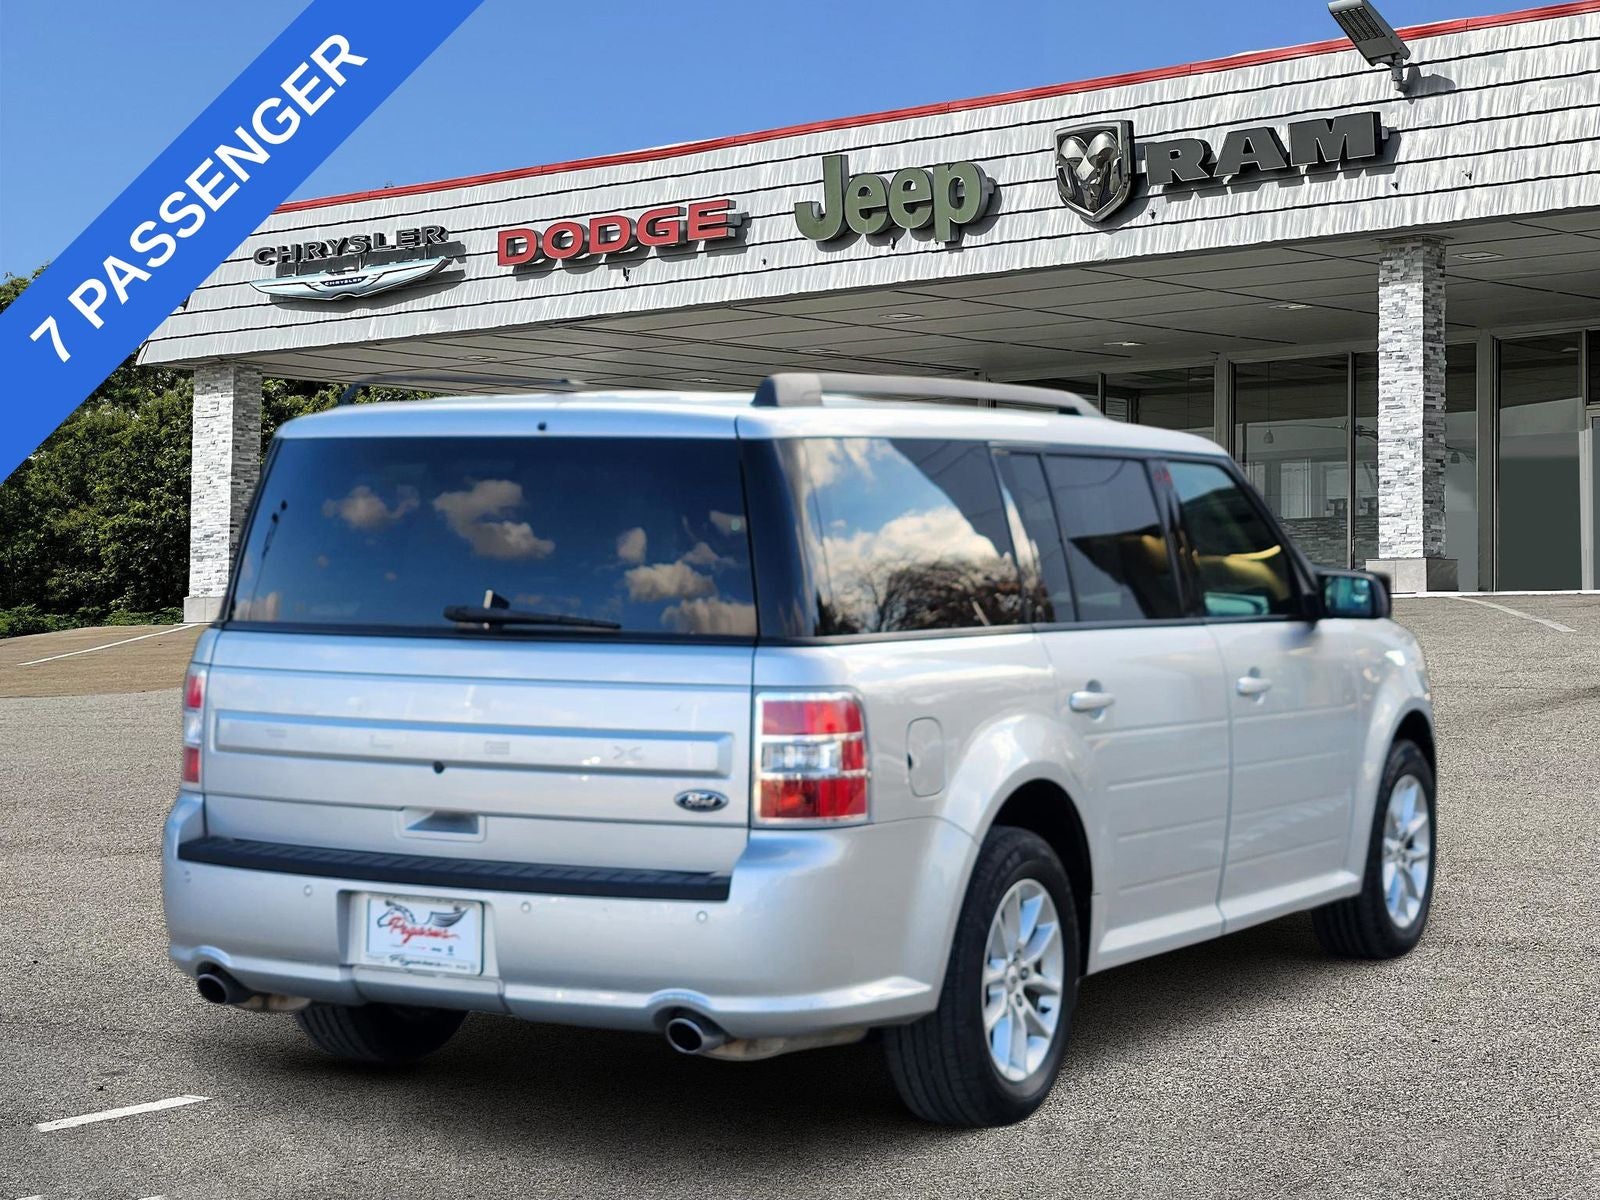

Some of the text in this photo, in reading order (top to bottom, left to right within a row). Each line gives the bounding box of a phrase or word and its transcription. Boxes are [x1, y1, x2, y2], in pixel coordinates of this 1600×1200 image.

[1145, 112, 1381, 186] RAM
[795, 154, 988, 242] Jeep
[253, 225, 449, 266] CHRYSLER
[497, 199, 736, 266] DODGE
[324, 276, 363, 286] CHRYSLER
